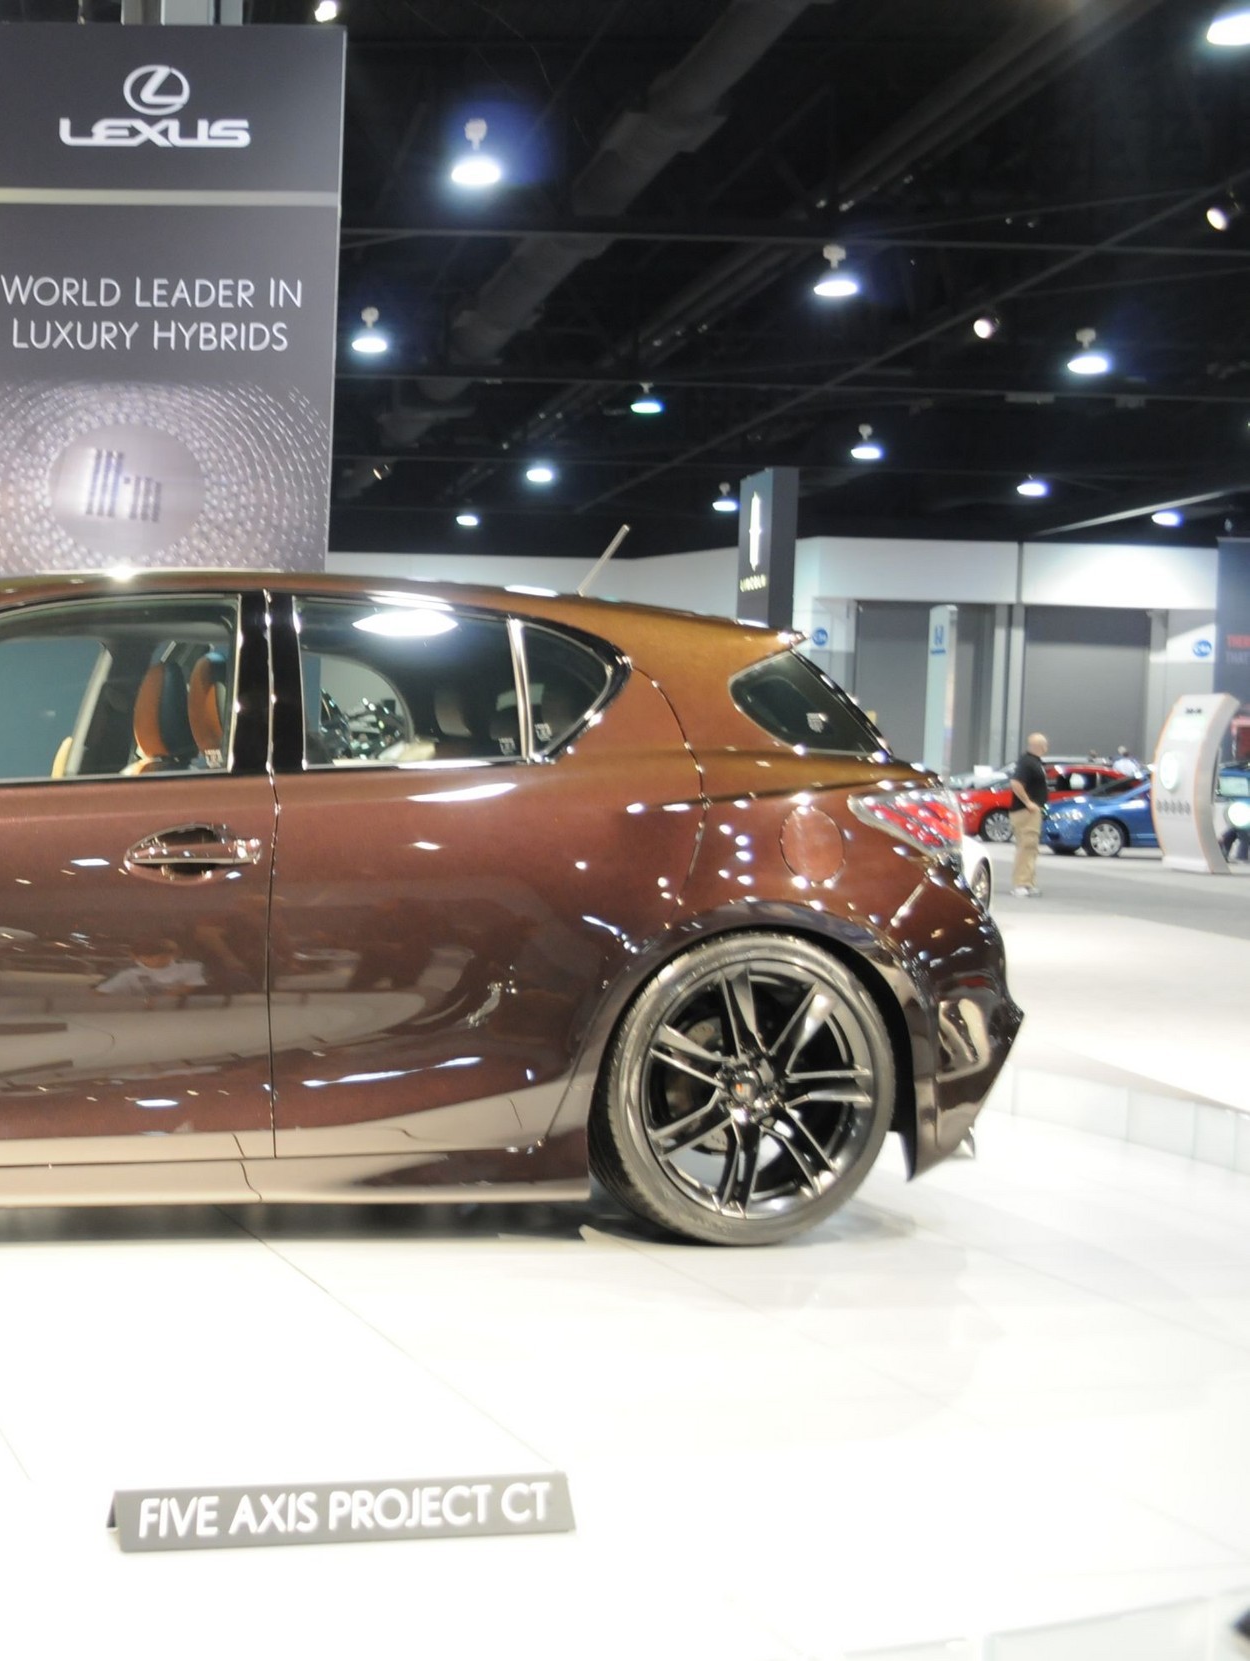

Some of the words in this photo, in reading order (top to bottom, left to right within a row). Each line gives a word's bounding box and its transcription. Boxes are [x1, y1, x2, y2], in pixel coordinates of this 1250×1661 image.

[59, 117, 251, 148] LEXUS
[0, 273, 121, 306] WORLD
[135, 276, 255, 308] LEADER
[269, 277, 302, 308] IN
[12, 317, 139, 350] LUXURY
[153, 320, 289, 351] HYBRIDS
[138, 1496, 218, 1538] FIVE
[229, 1492, 319, 1534] AXIS
[328, 1485, 492, 1530] PROJECT
[501, 1482, 552, 1524] CT
